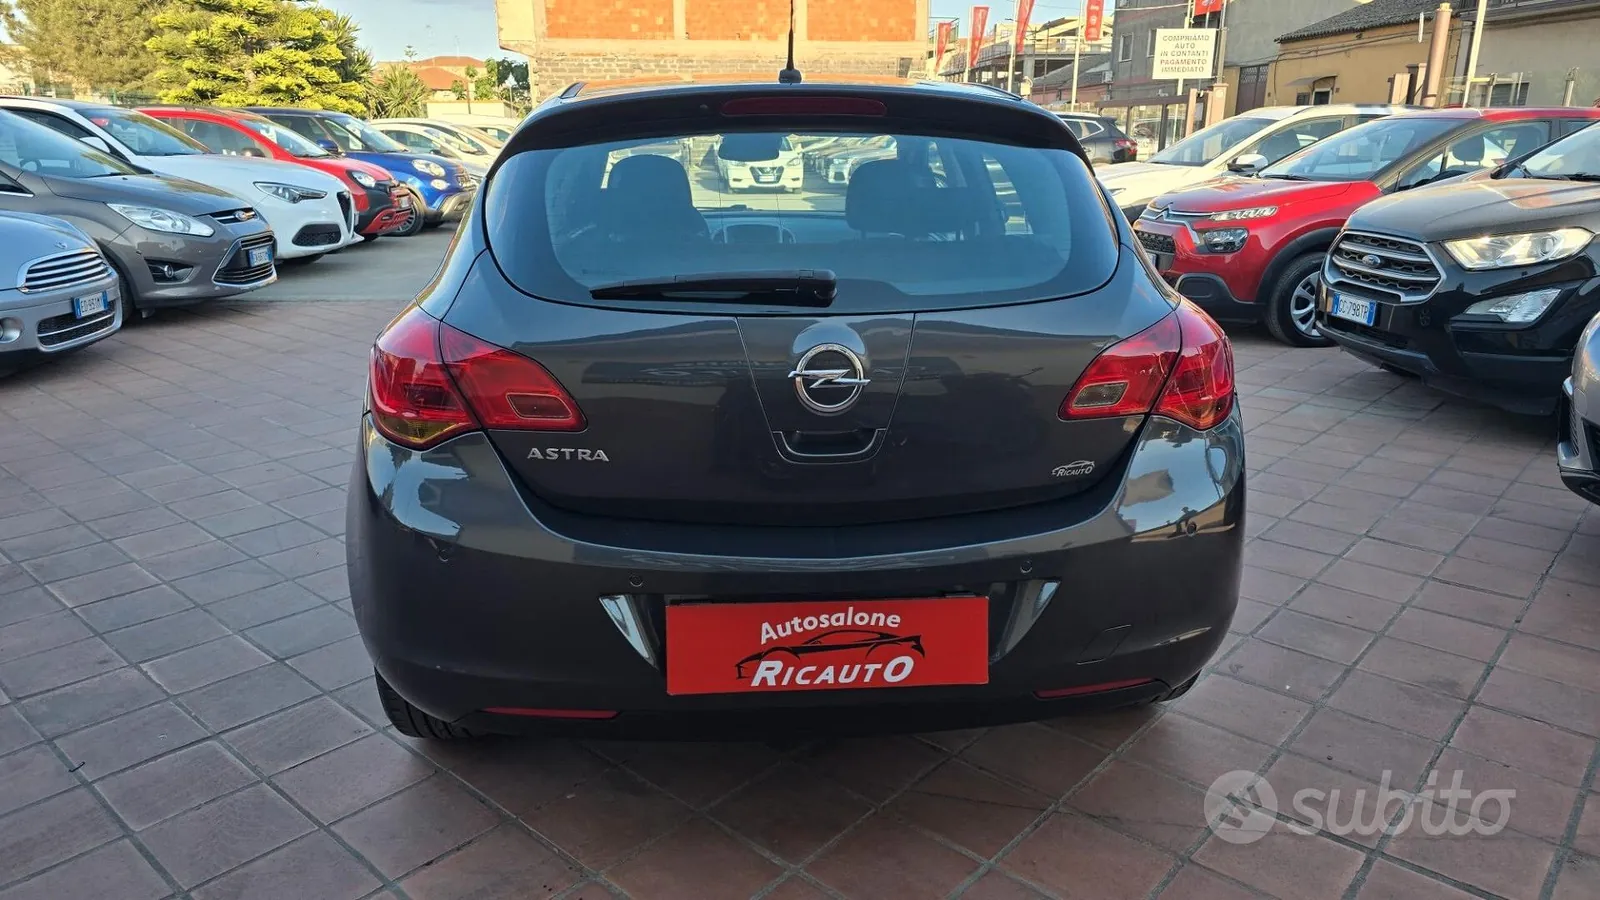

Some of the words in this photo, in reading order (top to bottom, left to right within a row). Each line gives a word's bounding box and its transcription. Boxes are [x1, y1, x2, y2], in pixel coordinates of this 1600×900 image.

[526, 447, 610, 462] ASTRA
[1056, 466, 1093, 477] RICAUTO
[760, 606, 902, 645] Autosalone
[750, 655, 914, 687] RICAUTO
